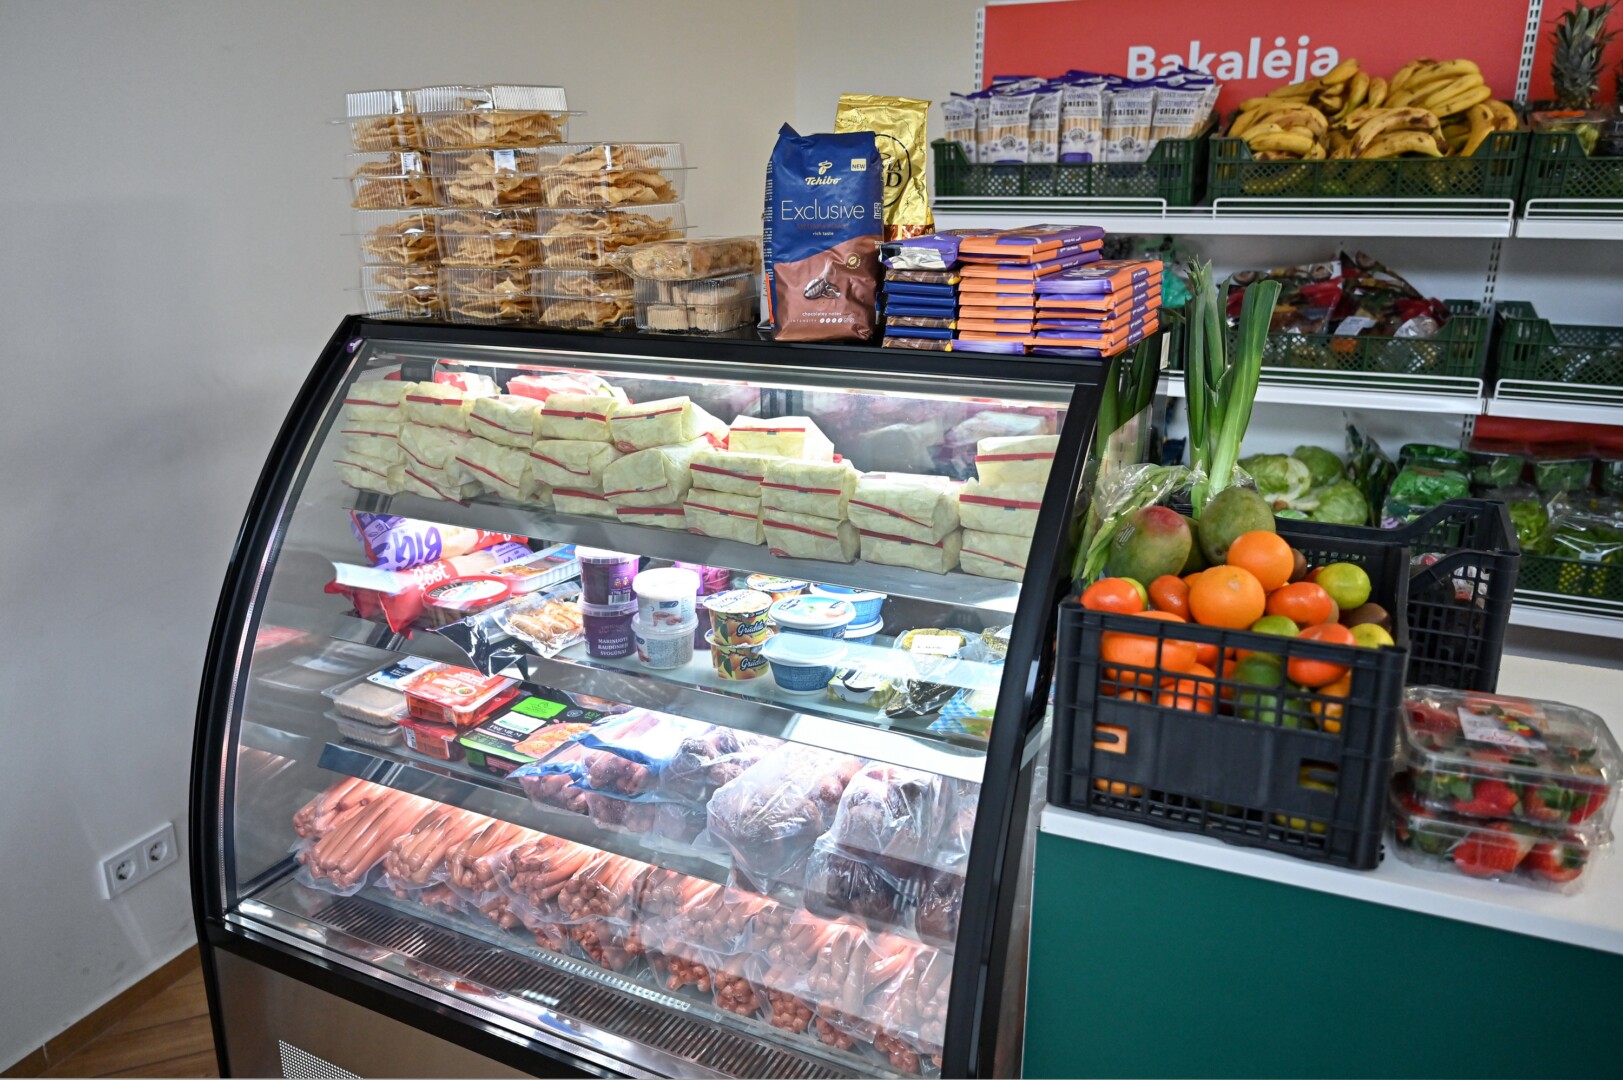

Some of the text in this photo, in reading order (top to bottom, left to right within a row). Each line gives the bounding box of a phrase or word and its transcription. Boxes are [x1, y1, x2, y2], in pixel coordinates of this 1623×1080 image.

[1127, 35, 1339, 86] Bakalėja
[805, 176, 841, 185] Tchibo
[781, 198, 865, 220] Exclusive
[598, 636, 628, 644] MARINUOTI
[488, 725, 523, 738] PREMIUM
